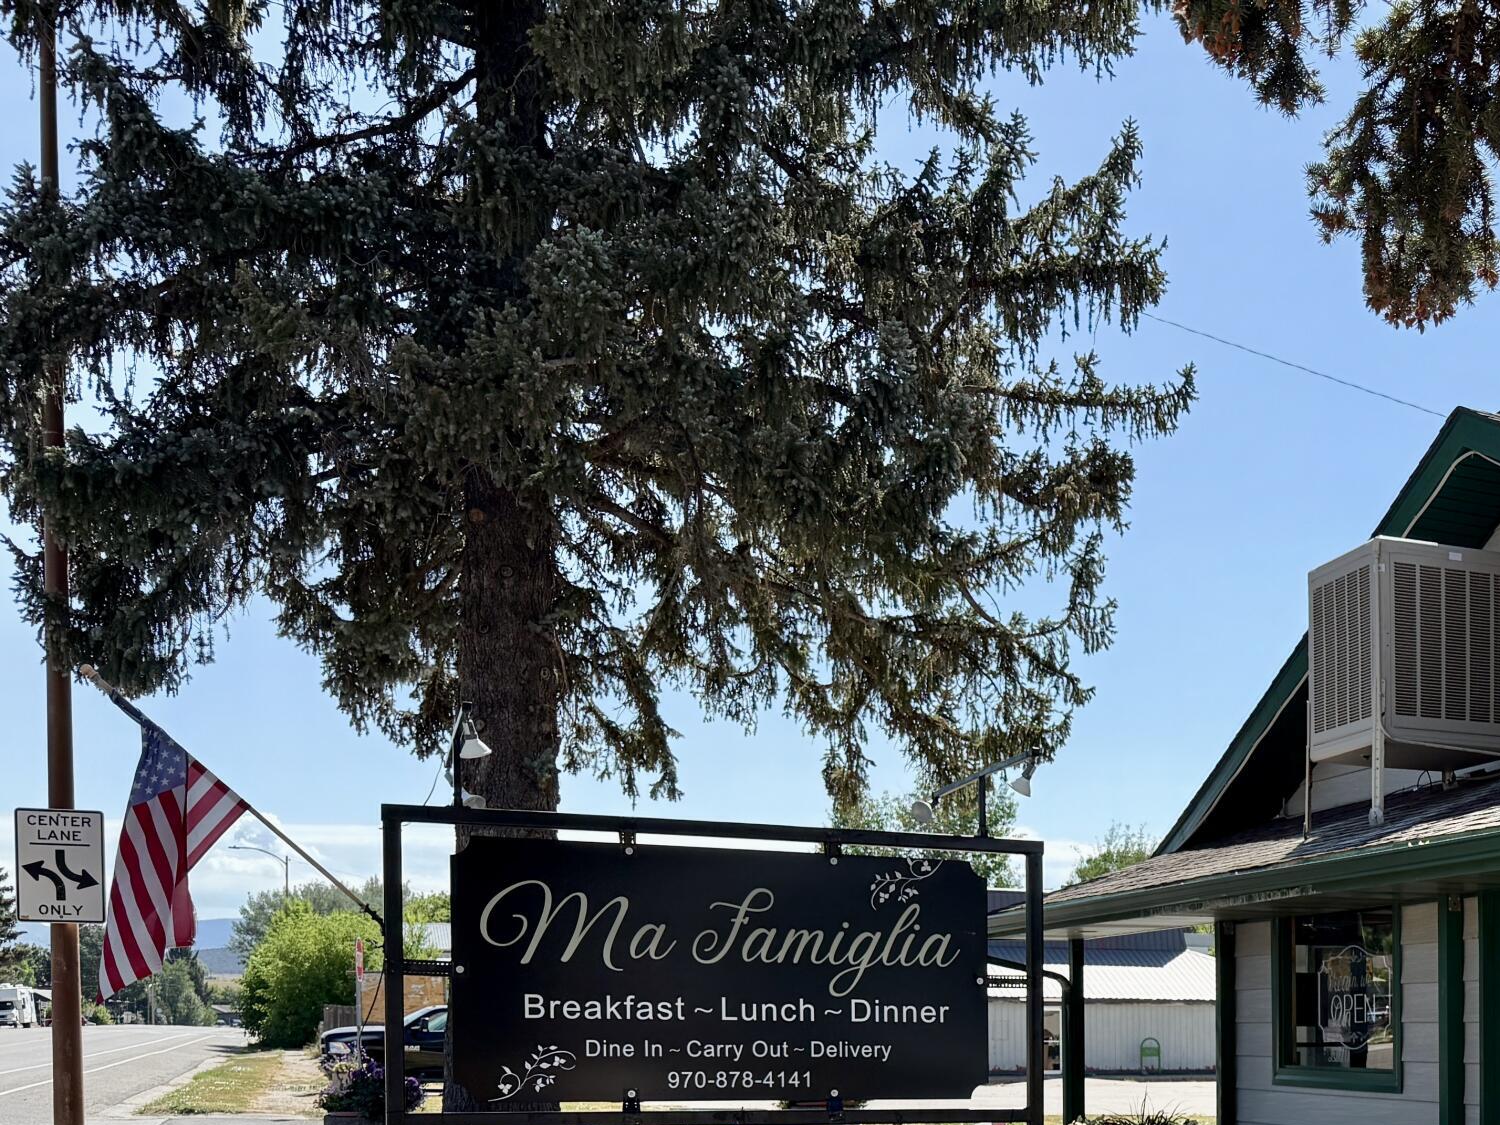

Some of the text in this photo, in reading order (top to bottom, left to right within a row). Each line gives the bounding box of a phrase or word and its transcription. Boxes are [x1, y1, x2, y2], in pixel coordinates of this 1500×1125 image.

[27, 814, 91, 827] CENTER
[37, 829, 82, 841] LANE
[38, 904, 83, 916] ONLY
[480, 880, 960, 997] Ma Famiglia
[524, 993, 685, 1020] Breakfast
[721, 997, 815, 1021] Lunch
[851, 999, 950, 1023] Dinner
[1330, 993, 1376, 1024] OPEN
[585, 1040, 635, 1057] Dine
[644, 1040, 663, 1057] In
[686, 1040, 744, 1061] Carry
[752, 1040, 789, 1058] Out
[810, 1041, 892, 1062] Delivery
[667, 1070, 812, 1089] 970-878-4141
